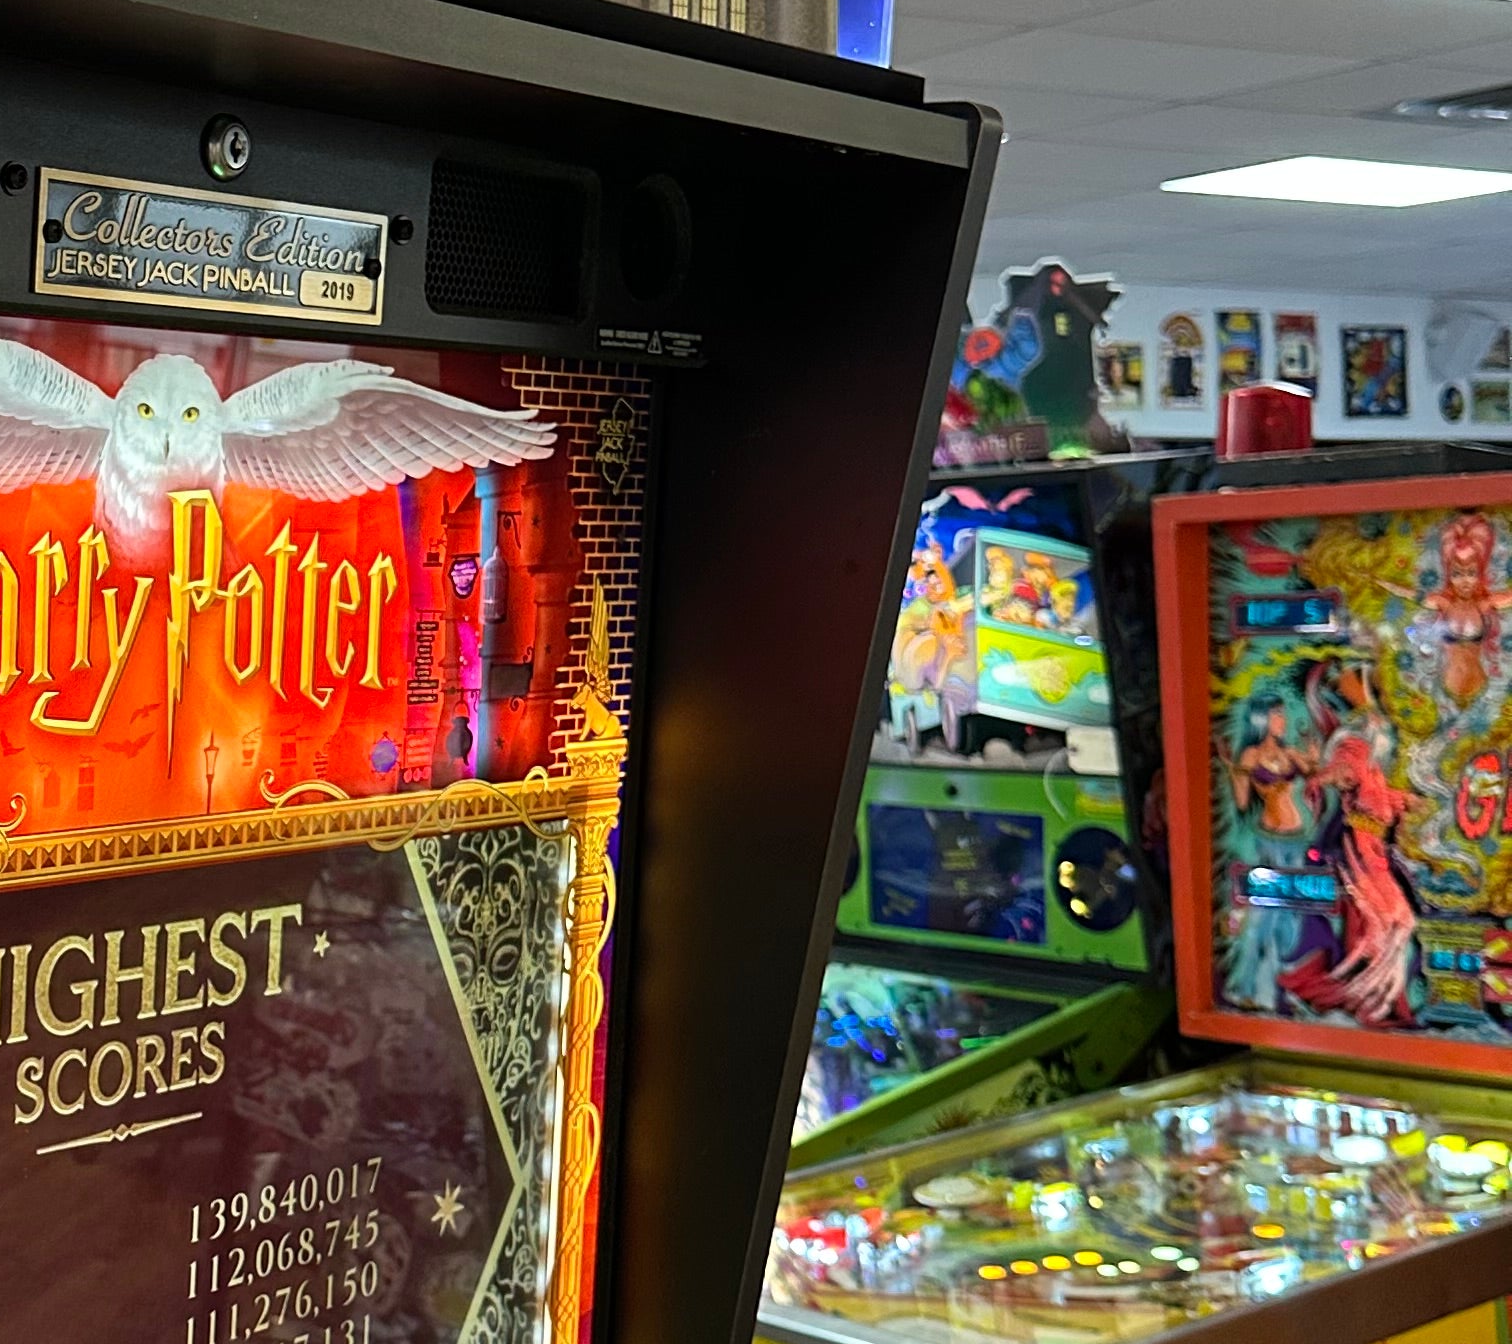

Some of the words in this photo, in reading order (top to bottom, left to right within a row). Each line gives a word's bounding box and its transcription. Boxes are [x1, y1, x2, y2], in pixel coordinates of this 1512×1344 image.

[47, 248, 138, 286] JERSEY
[136, 259, 199, 290] JACK
[202, 264, 296, 298] PINBALL
[62, 190, 234, 258] Collectors
[245, 217, 365, 274] Edition
[320, 279, 356, 303] 2019
[600, 437, 624, 451] JACK
[165, 489, 398, 778] Potter
[14, 1022, 226, 1124] SCORES
[190, 1157, 382, 1243] 139,840,017
[188, 1209, 380, 1299] 112,068,745
